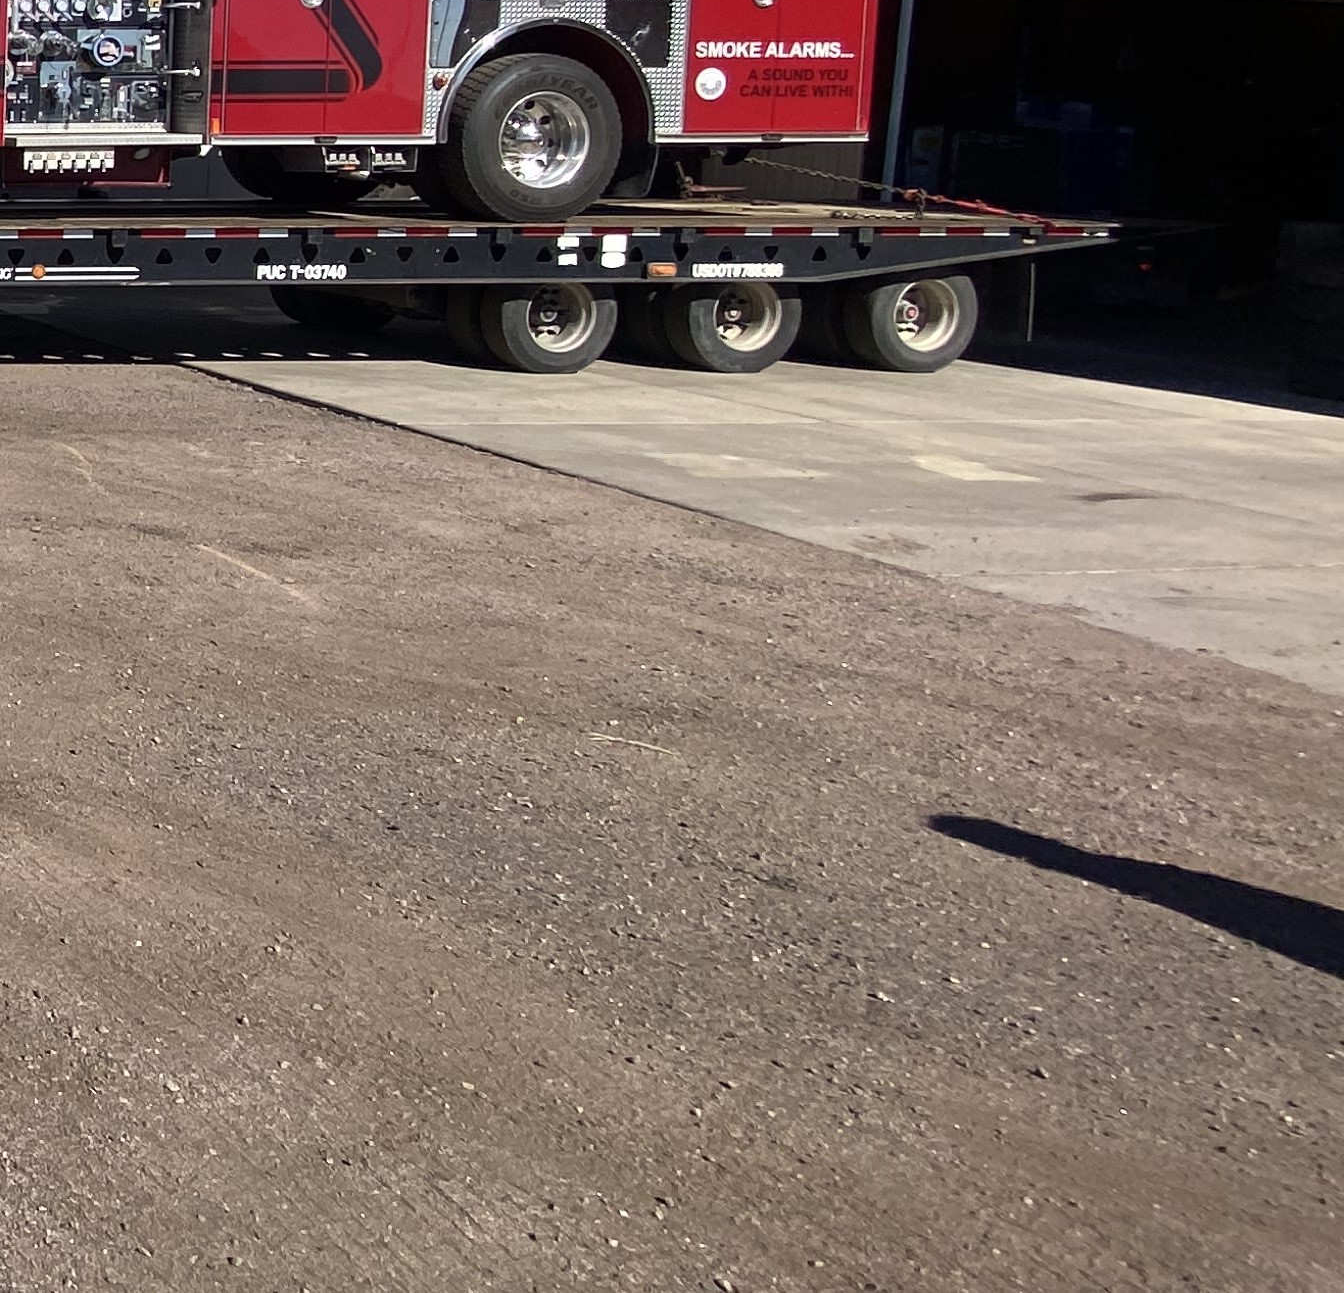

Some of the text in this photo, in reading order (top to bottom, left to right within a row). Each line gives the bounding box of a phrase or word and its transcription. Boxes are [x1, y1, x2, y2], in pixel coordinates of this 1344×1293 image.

[695, 41, 763, 59] SMOKE
[747, 68, 849, 82] A SOUND YOU
[739, 84, 773, 98] CAN
[774, 84, 811, 98] LIVE
[256, 264, 347, 280] PUC T-03740
